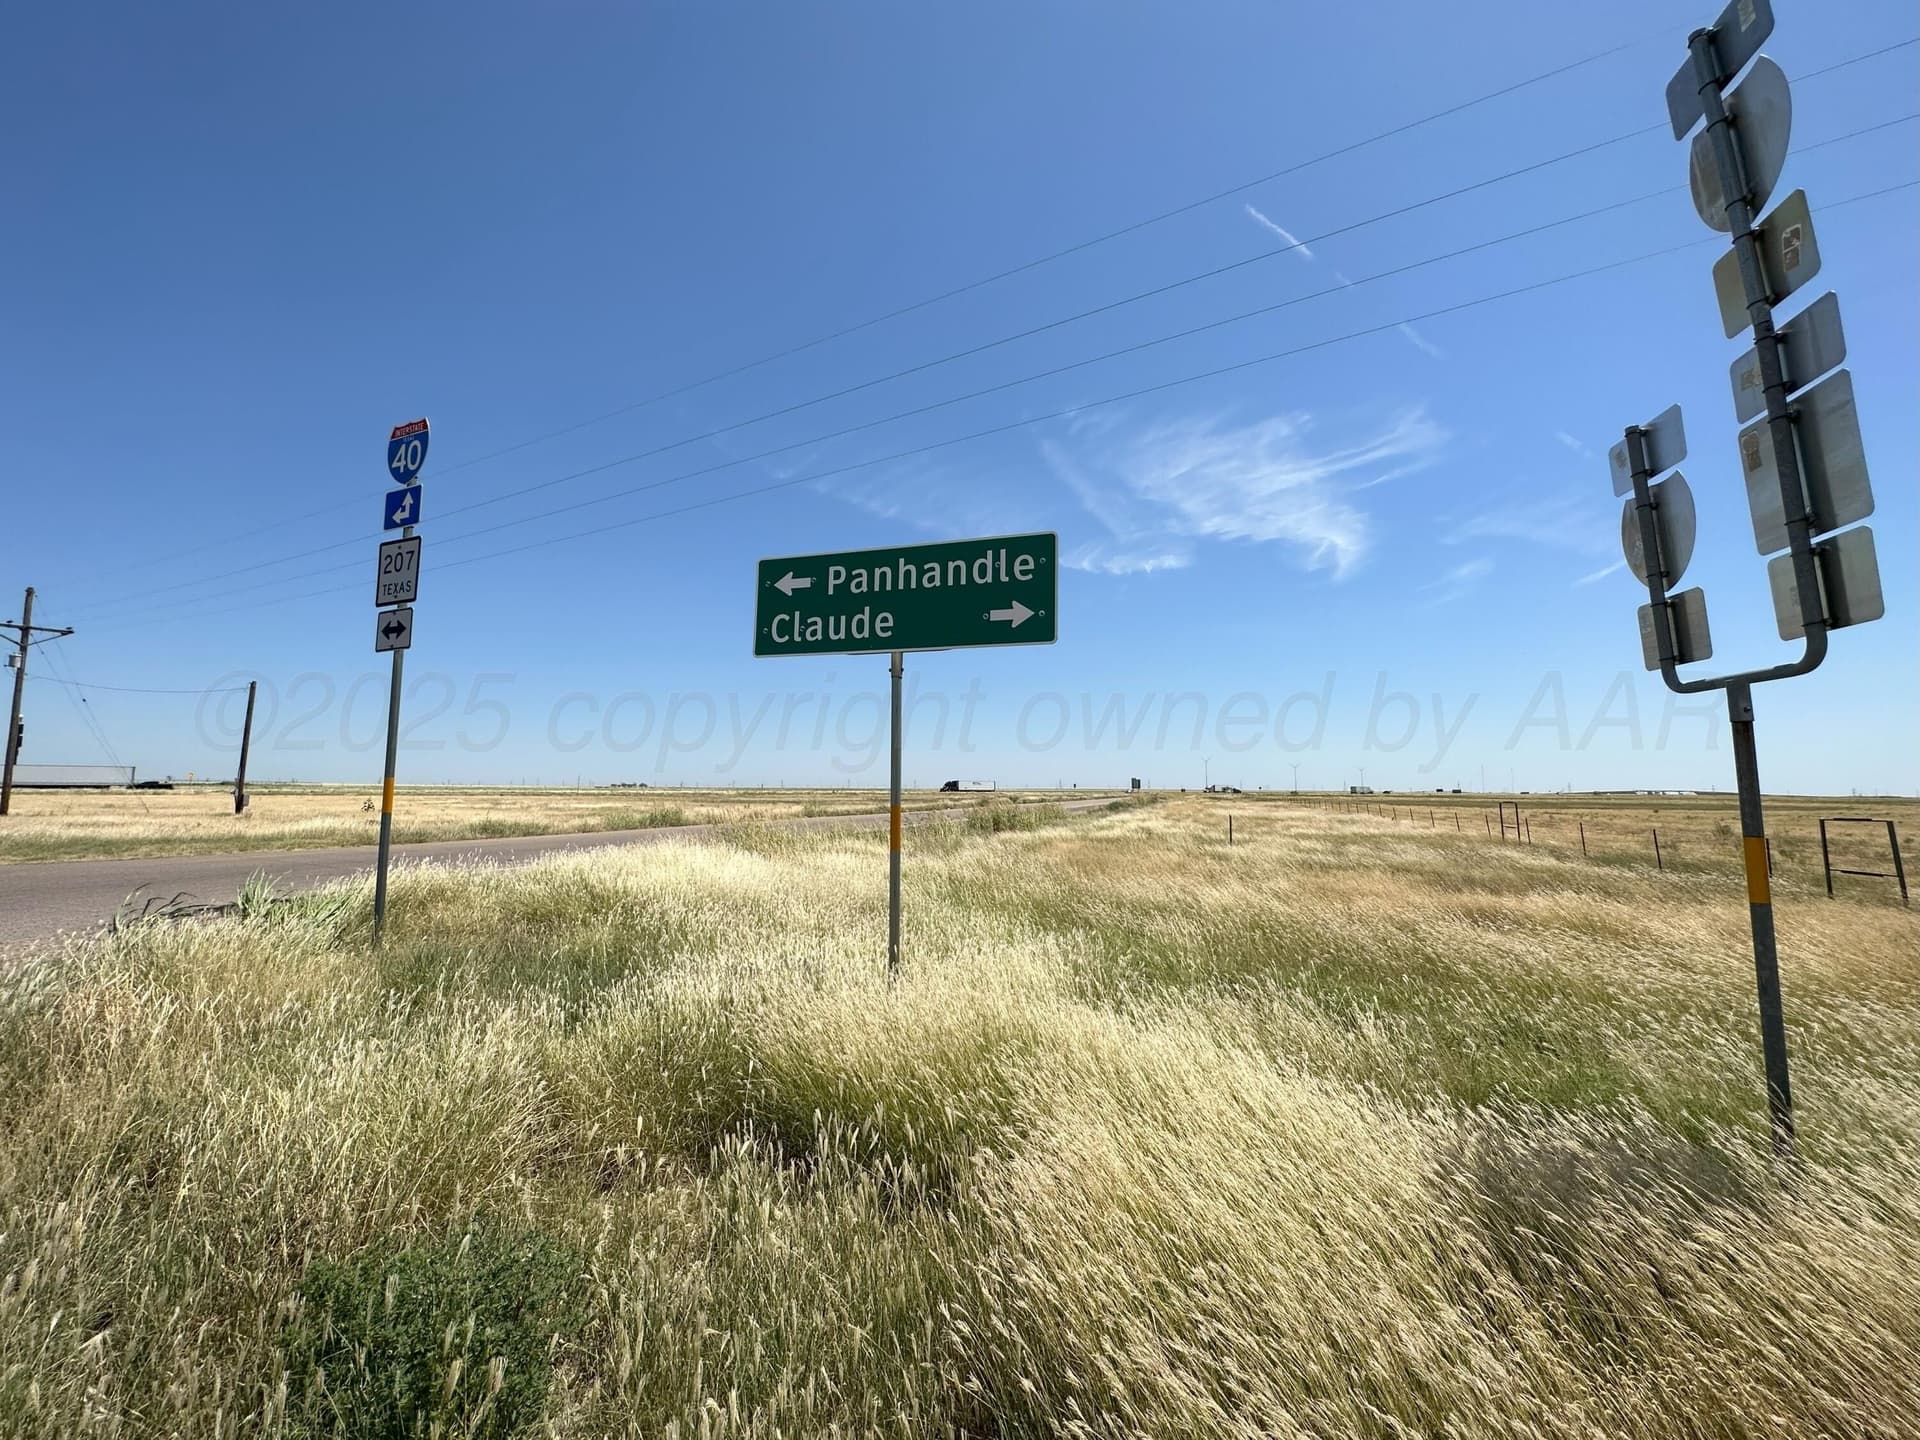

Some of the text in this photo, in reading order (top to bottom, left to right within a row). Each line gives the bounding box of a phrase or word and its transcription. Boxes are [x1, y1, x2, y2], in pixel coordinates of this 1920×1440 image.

[391, 439, 421, 472] 40
[383, 550, 415, 574] 207
[827, 549, 1035, 595] Panhandle
[383, 580, 412, 596] TEXAS
[770, 606, 895, 643] Claude
